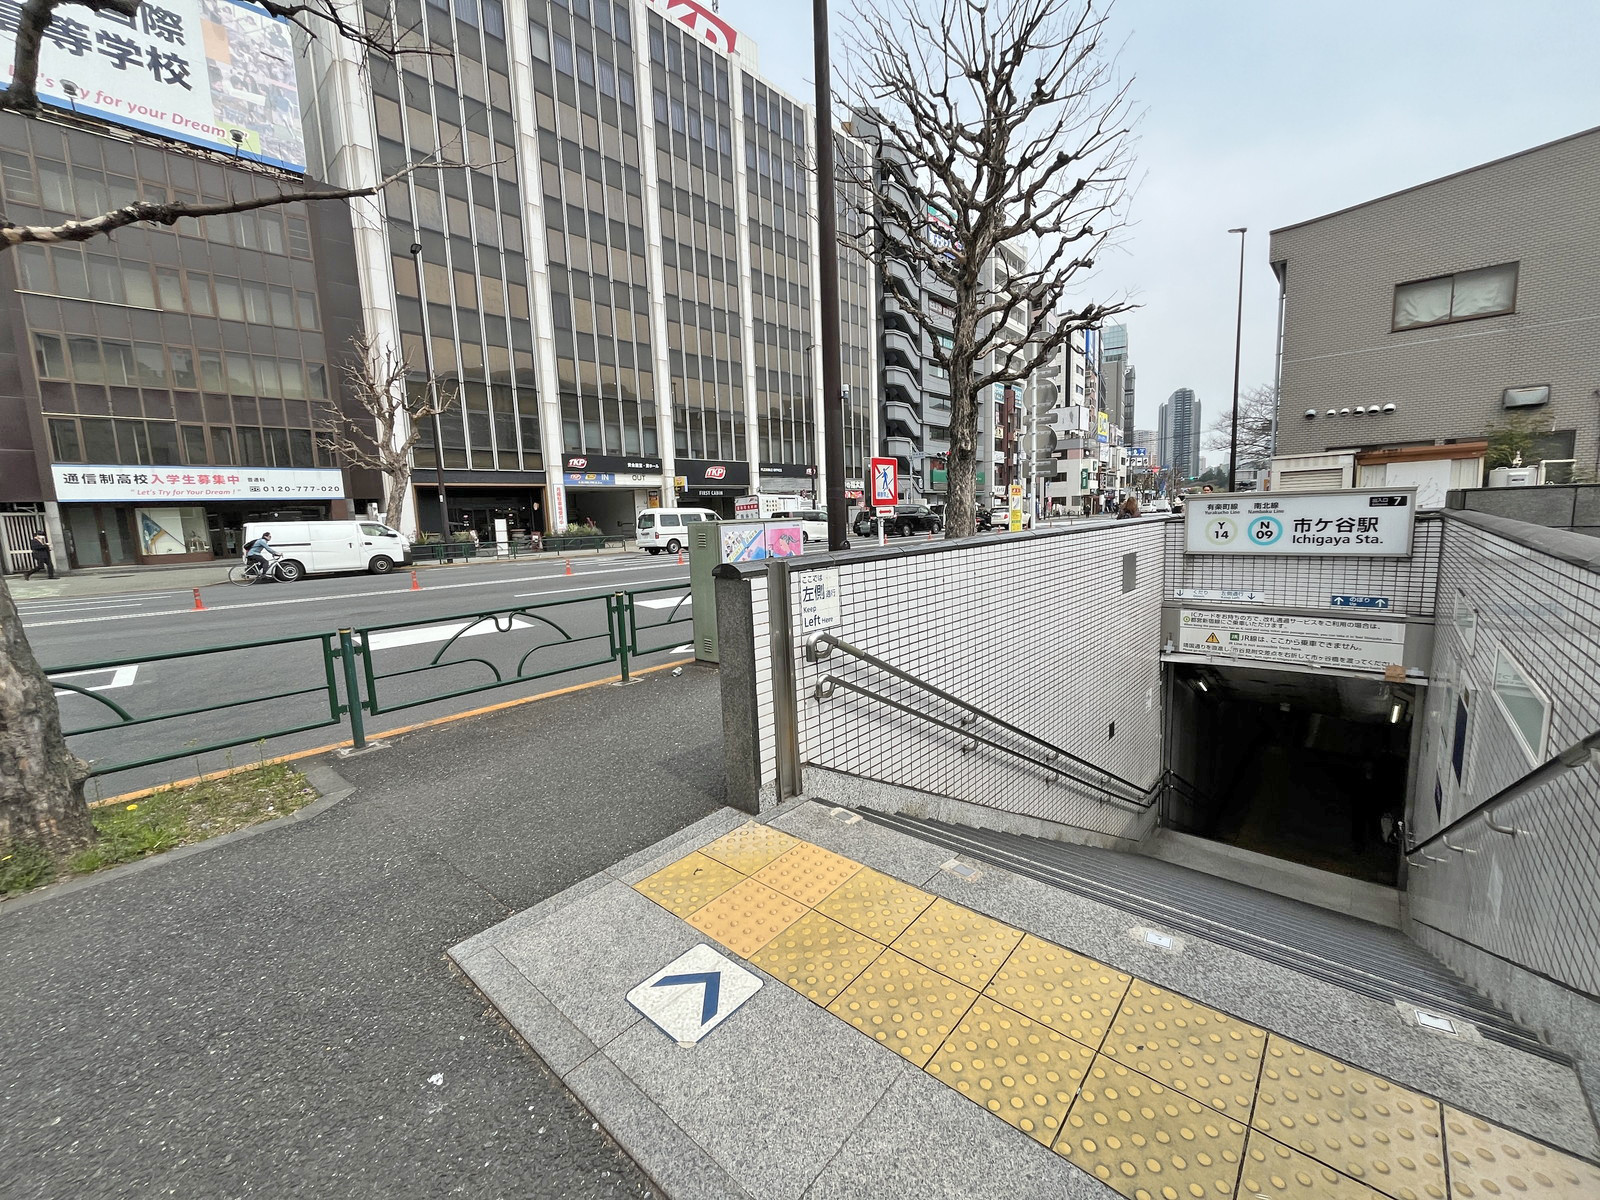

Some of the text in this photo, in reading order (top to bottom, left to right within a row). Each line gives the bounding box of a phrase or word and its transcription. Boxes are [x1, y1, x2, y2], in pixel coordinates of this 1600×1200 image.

[96, 90, 123, 107] for
[127, 101, 168, 122] your
[172, 113, 227, 138] Dream
[568, 459, 586, 467] TKP
[706, 467, 725, 478] TKP
[62, 474, 240, 485] 通信制高校入学生募集中
[1394, 496, 1402, 506] 7
[1214, 531, 1229, 539] 14
[1256, 530, 1273, 539] 09
[1292, 534, 1384, 546] Ichigaya Sta.
[802, 574, 823, 584] ここでは
[804, 615, 821, 627] Left
